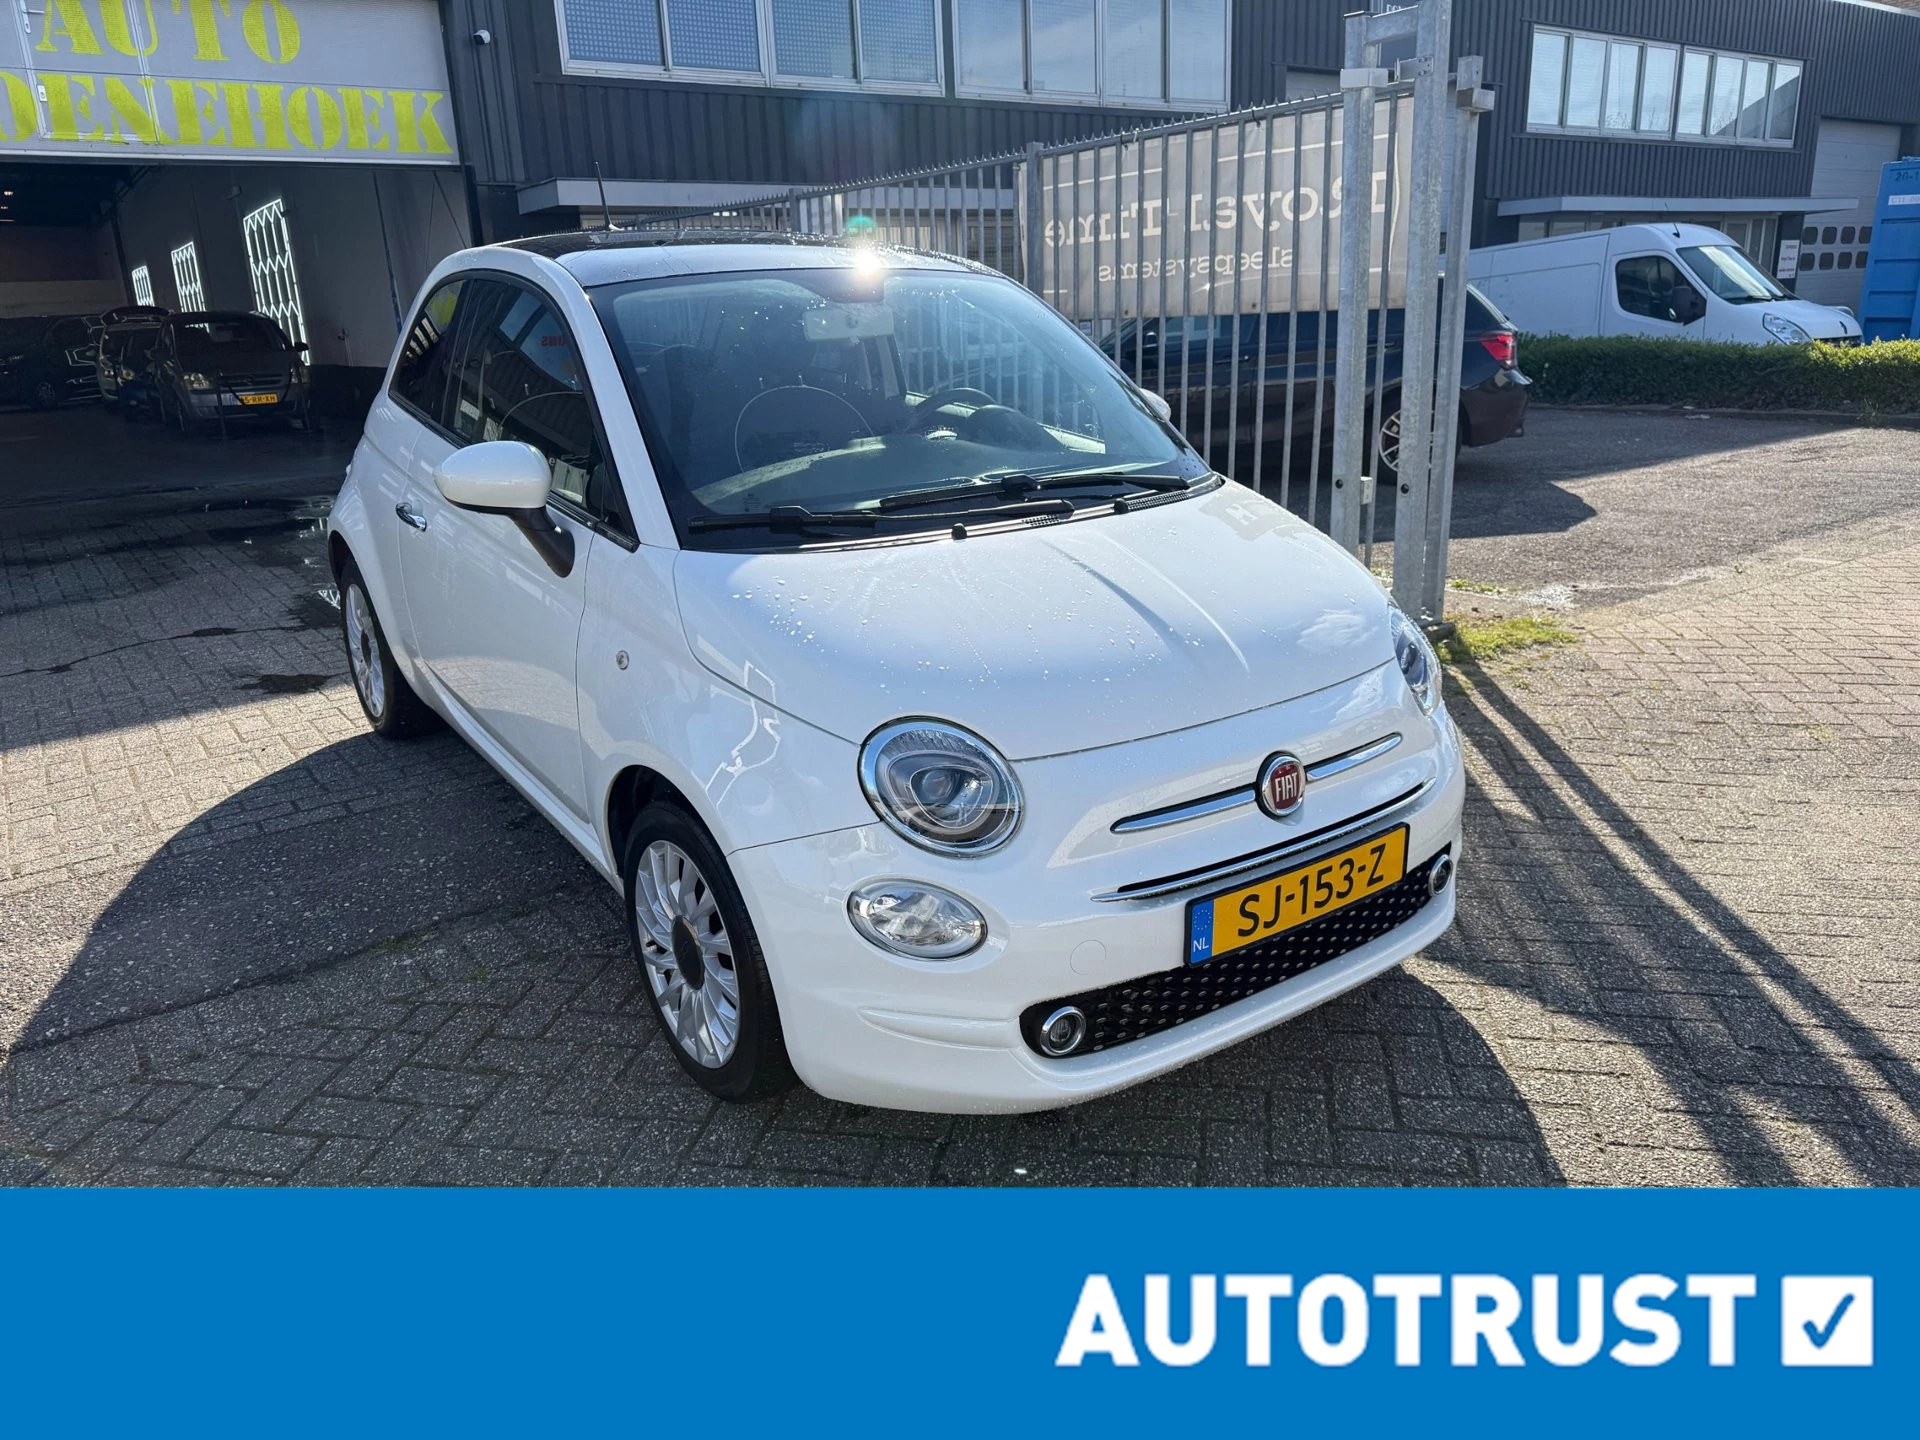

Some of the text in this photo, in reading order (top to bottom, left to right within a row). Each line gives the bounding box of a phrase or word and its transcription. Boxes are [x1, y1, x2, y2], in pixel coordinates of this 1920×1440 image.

[35, 0, 301, 64] AUTO
[1274, 772, 1300, 802] FIAT
[1237, 842, 1387, 937] SJ-153-Z
[1192, 937, 1210, 953] NL
